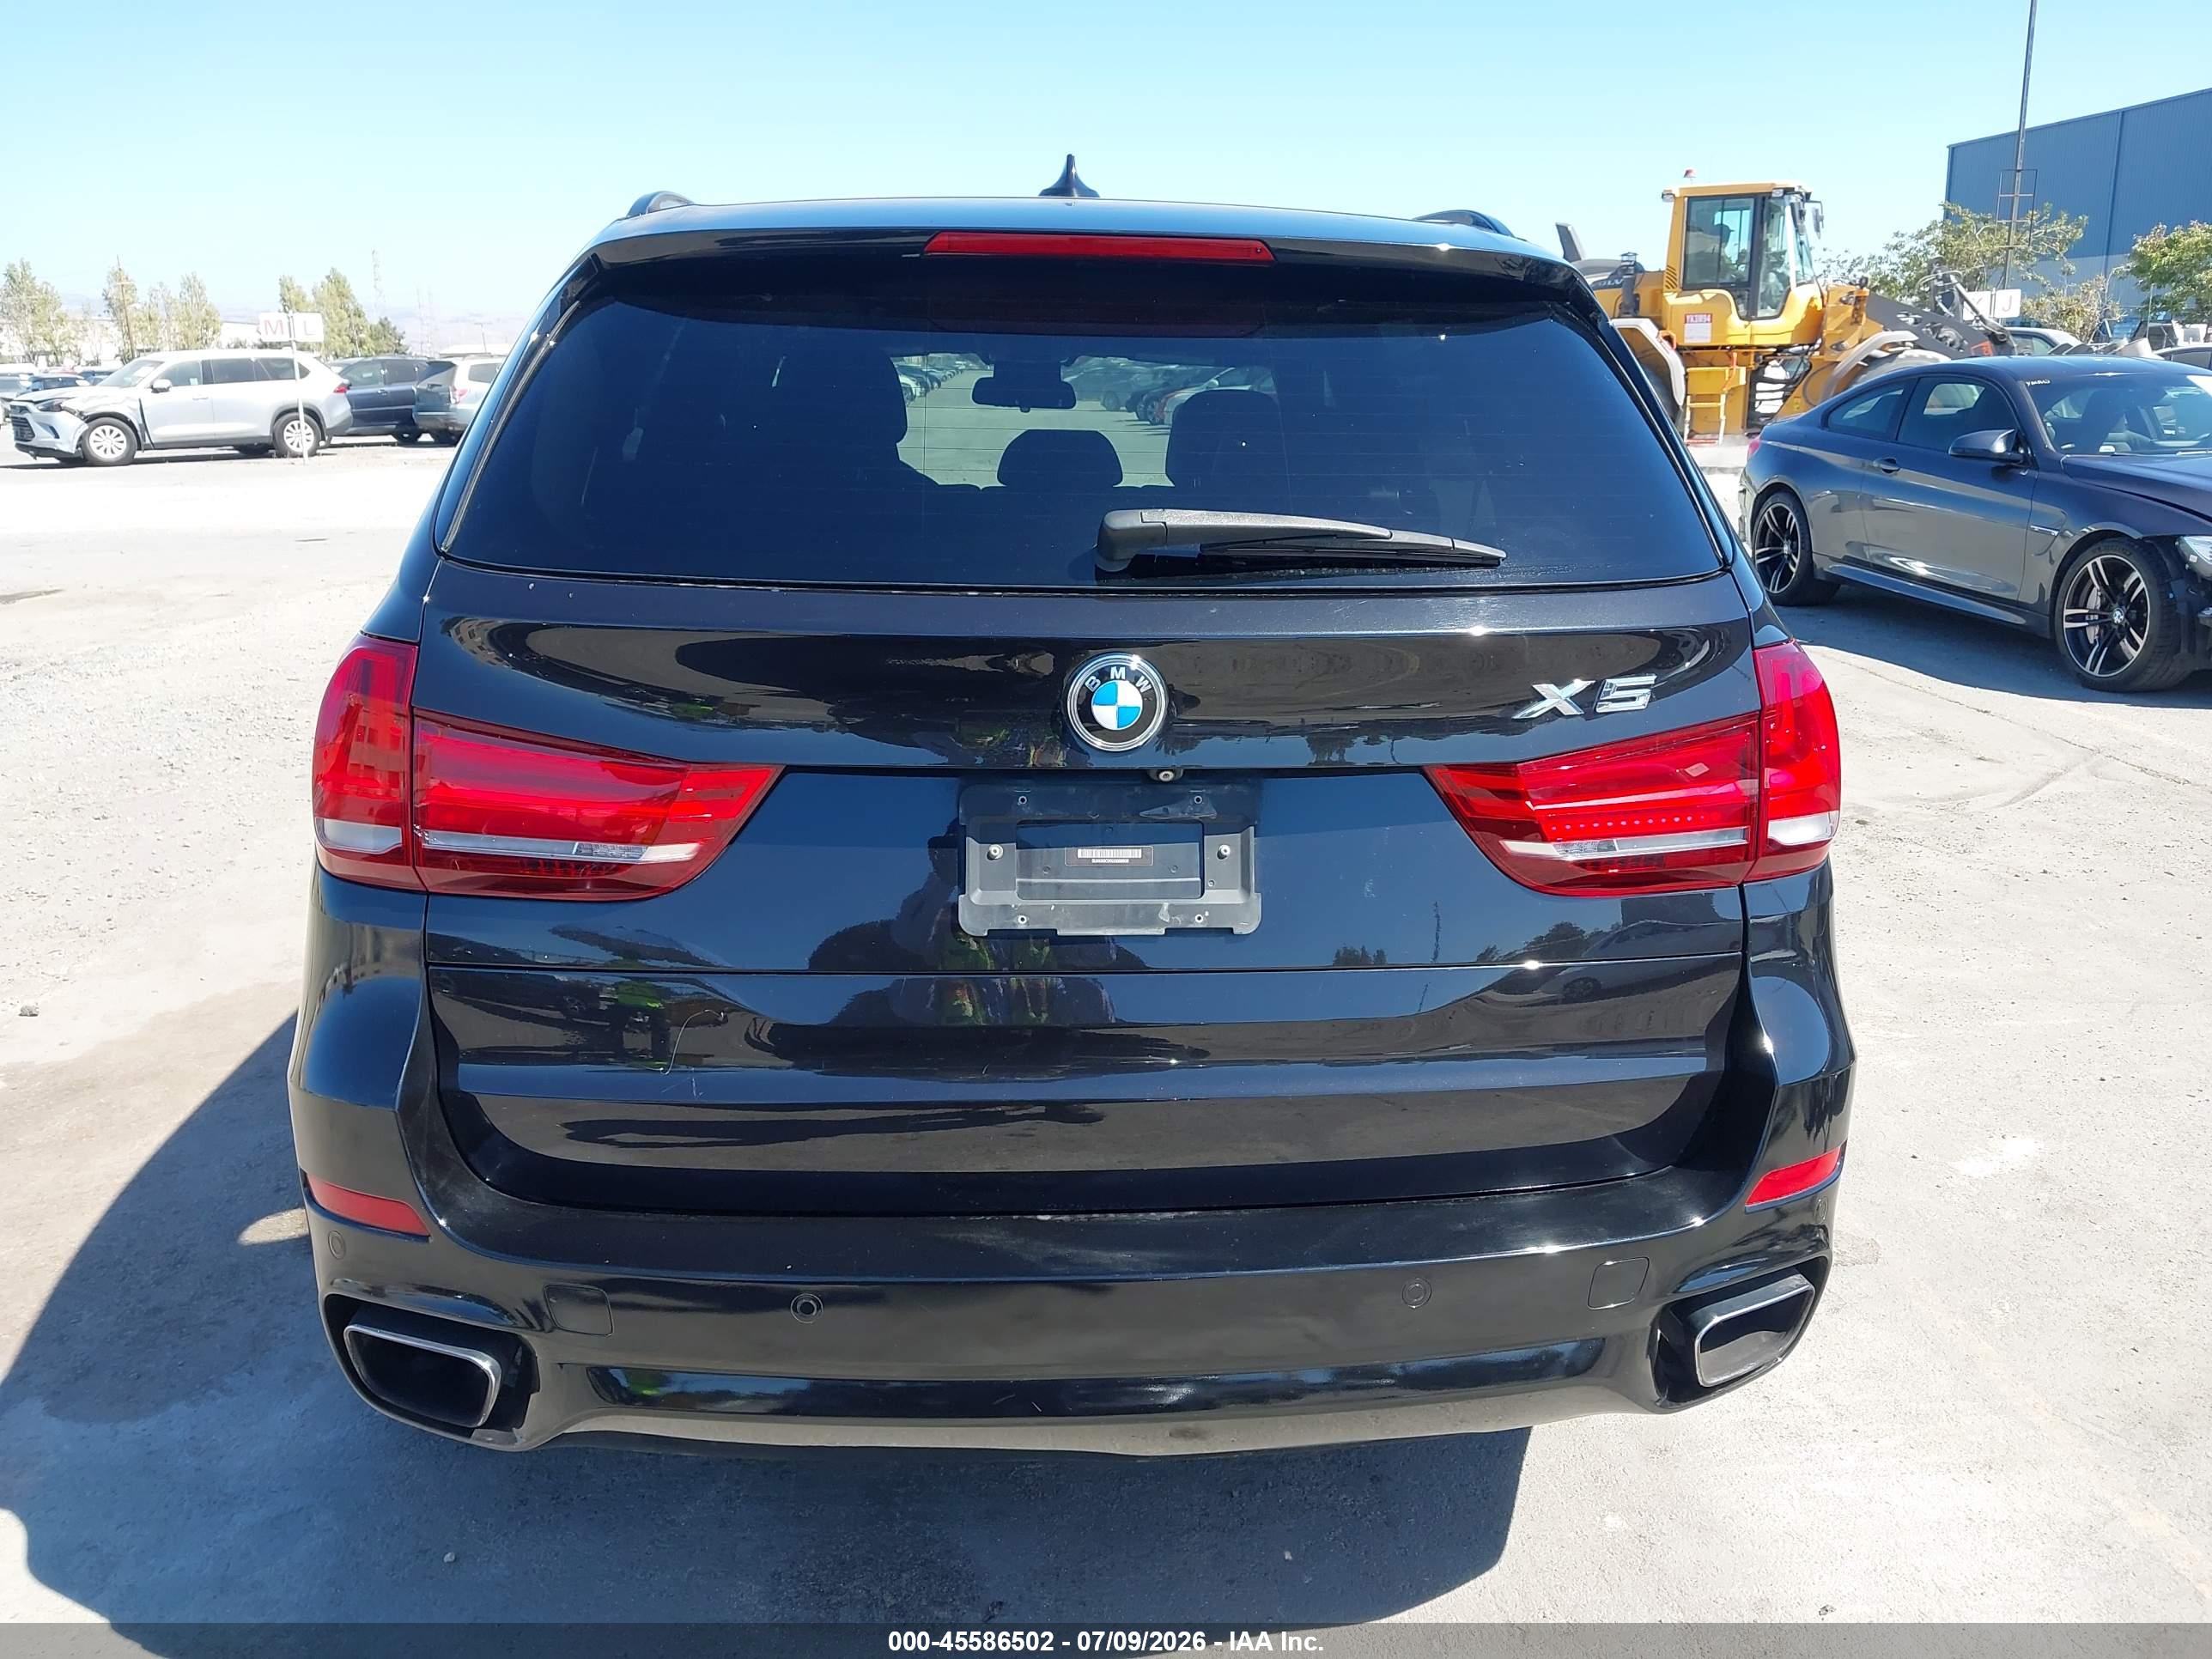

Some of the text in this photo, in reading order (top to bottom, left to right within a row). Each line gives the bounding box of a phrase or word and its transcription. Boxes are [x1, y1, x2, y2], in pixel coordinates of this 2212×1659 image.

[2002, 295, 2013, 313] J
[264, 319, 284, 336] M
[303, 319, 317, 336] L
[1085, 665, 1152, 693] BMW
[1511, 675, 1658, 720] X5
